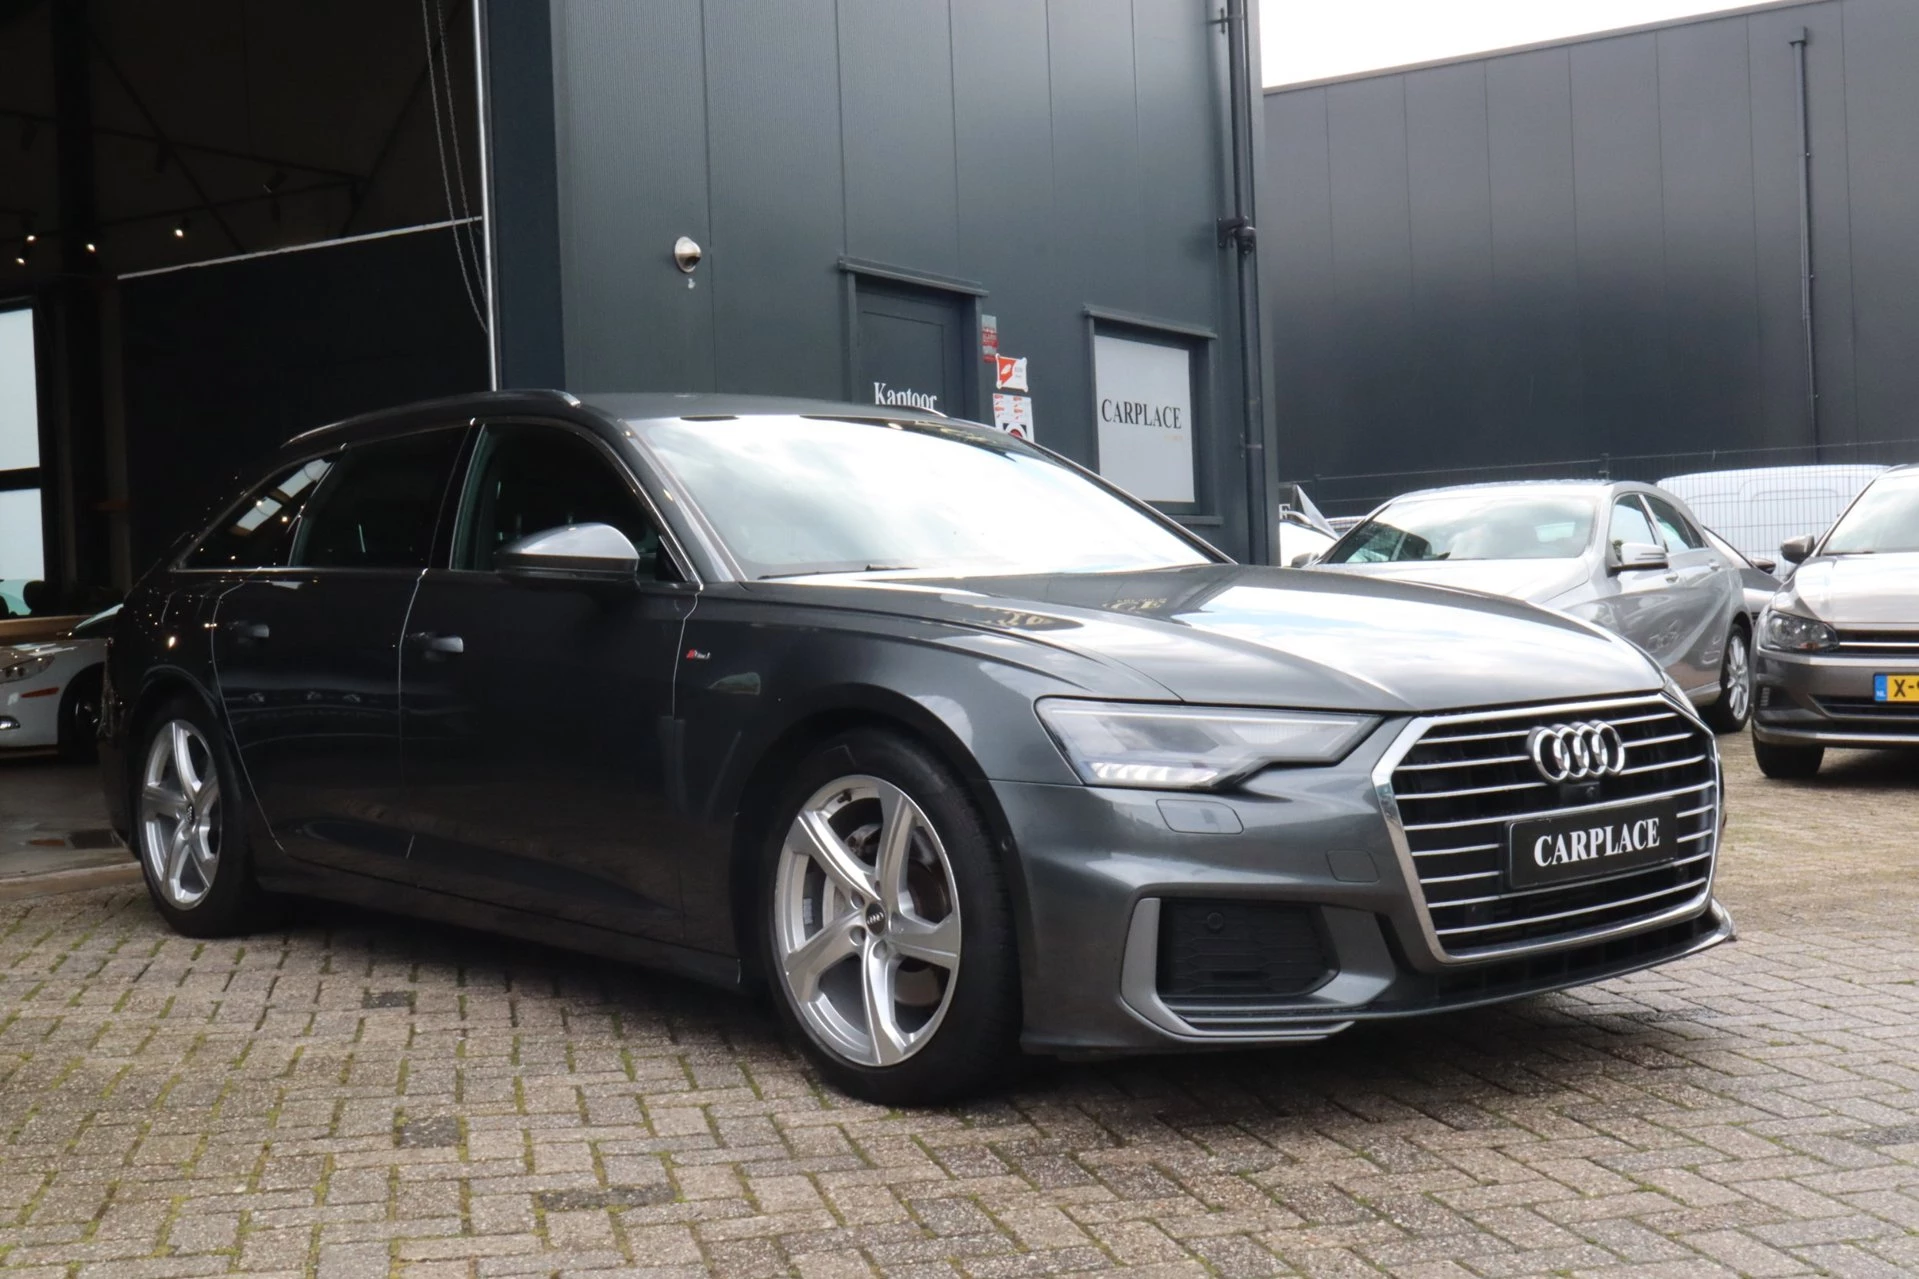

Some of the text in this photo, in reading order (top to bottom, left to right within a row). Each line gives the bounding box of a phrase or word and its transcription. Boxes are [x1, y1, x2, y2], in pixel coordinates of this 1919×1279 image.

[873, 382, 938, 410] Kantoor
[1101, 398, 1182, 430] CARPLACE
[1894, 679, 1919, 698] X-
[1534, 817, 1661, 868] CARPLACE
